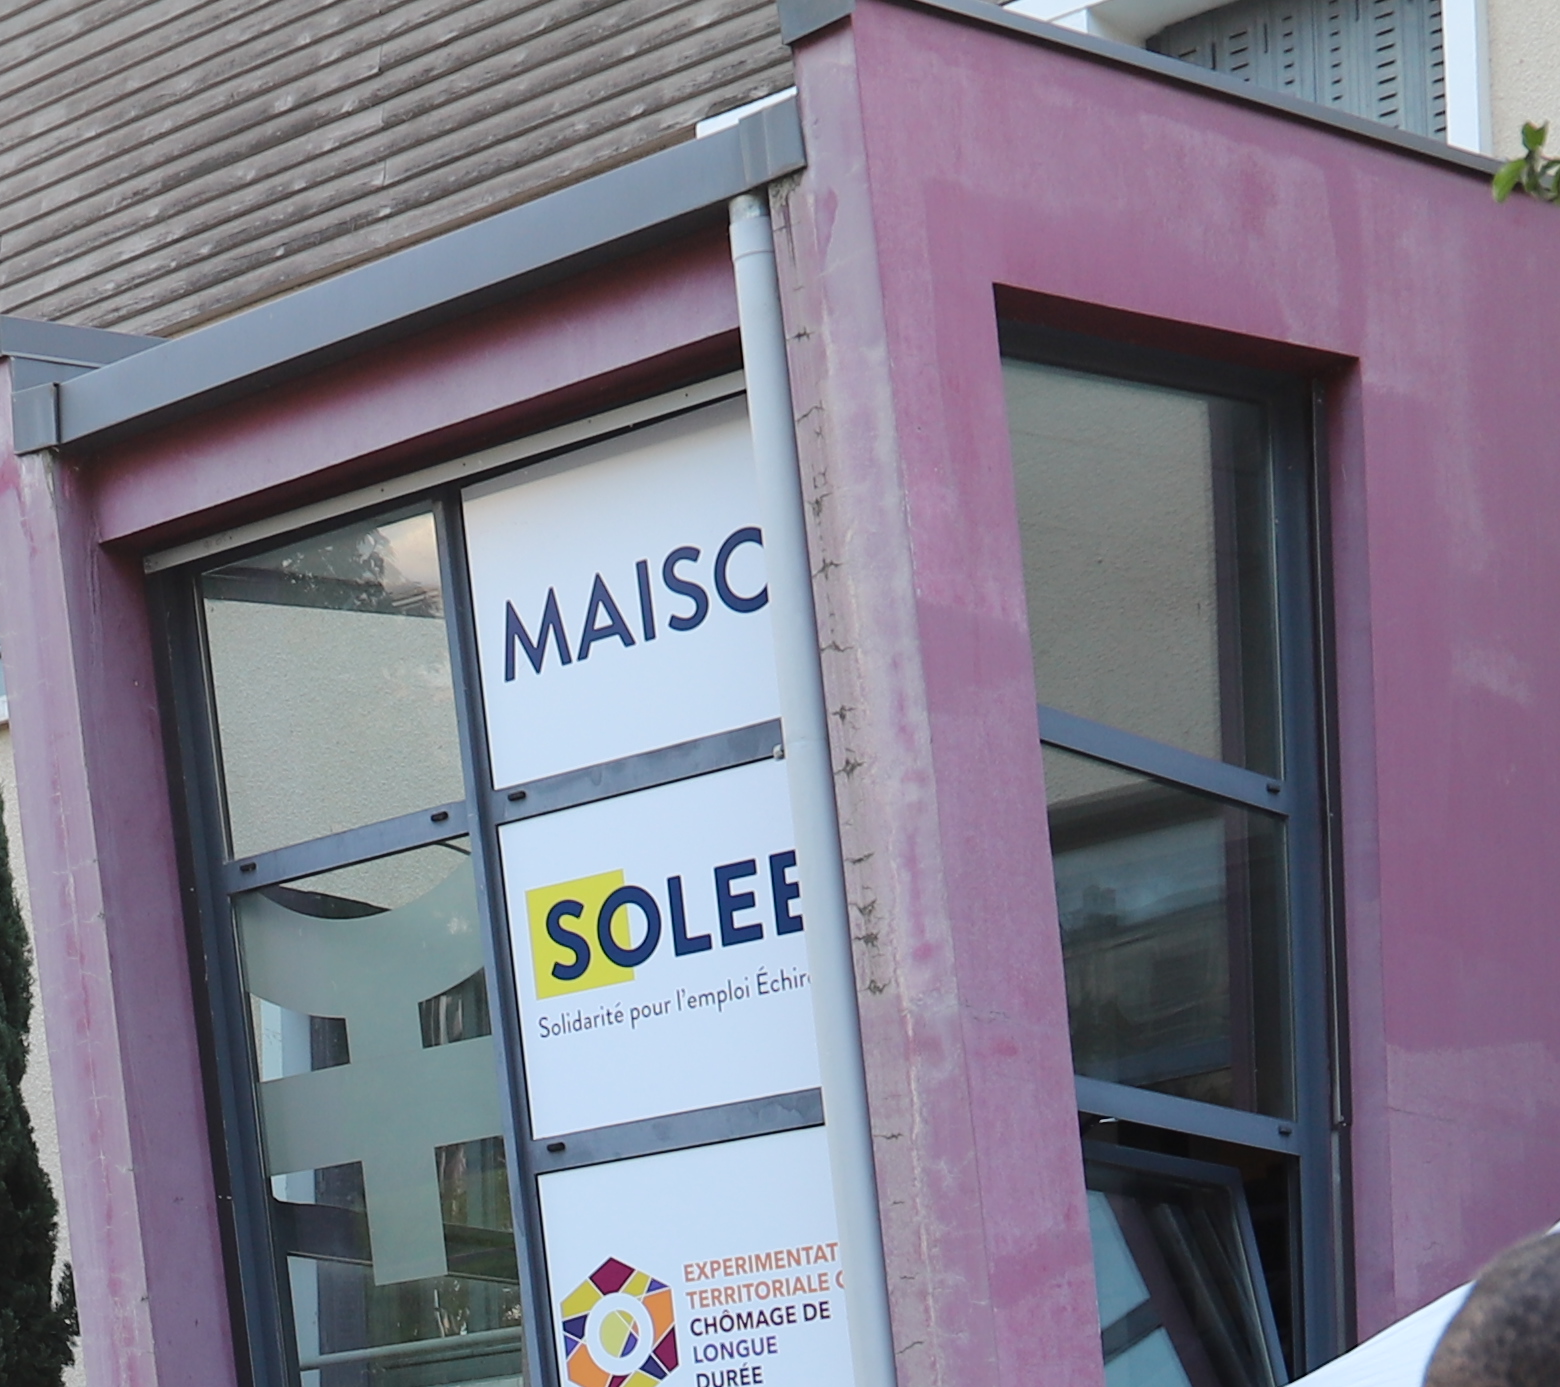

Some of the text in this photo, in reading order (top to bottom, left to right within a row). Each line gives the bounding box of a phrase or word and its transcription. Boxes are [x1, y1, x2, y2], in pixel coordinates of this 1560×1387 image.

[538, 1002, 625, 1038] Solidarité
[629, 998, 671, 1029] pour
[756, 965, 812, 996] Échir
[683, 1242, 839, 1283] EXPERIMENTAT
[685, 1272, 831, 1310] TERRITORIALE
[690, 1300, 831, 1336] CHÔMAGE DE
[693, 1335, 778, 1364] LONGUE
